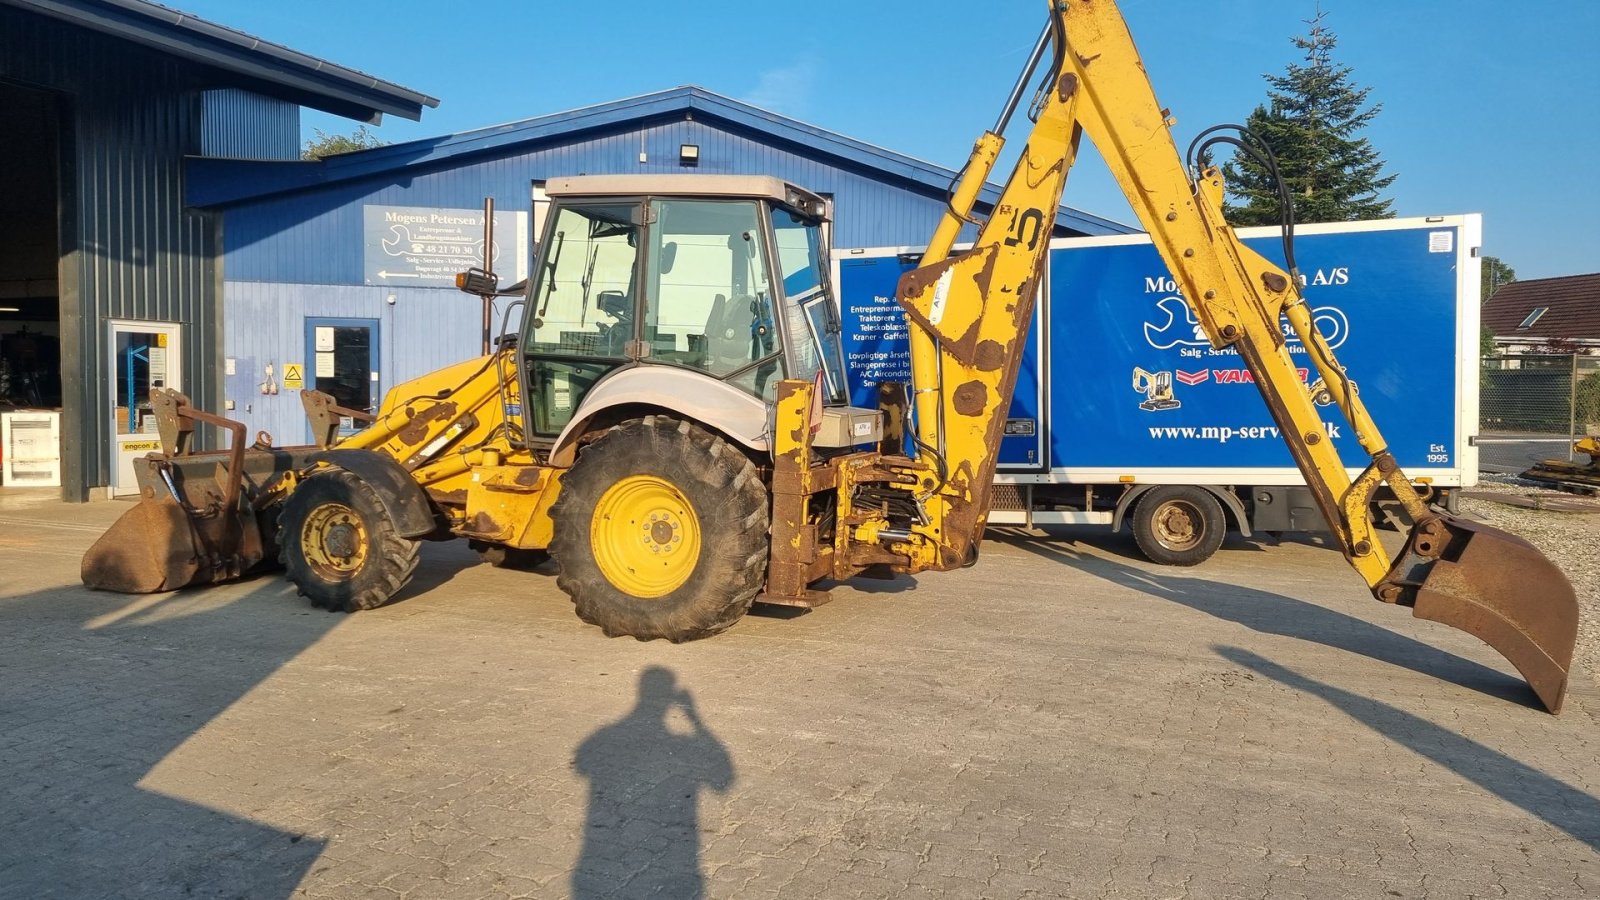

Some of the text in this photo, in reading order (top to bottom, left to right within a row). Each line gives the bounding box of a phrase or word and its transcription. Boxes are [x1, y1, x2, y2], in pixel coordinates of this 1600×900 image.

[385, 212, 498, 226] Mogens Petersen AS
[1312, 268, 1348, 286] A/S
[860, 324, 908, 332] Teleskoblæss
[1180, 346, 1240, 358] Salg Servi
[850, 362, 896, 370] Slangepresse
[1430, 444, 1446, 452] Est.
[1427, 454, 1448, 462] 1995
